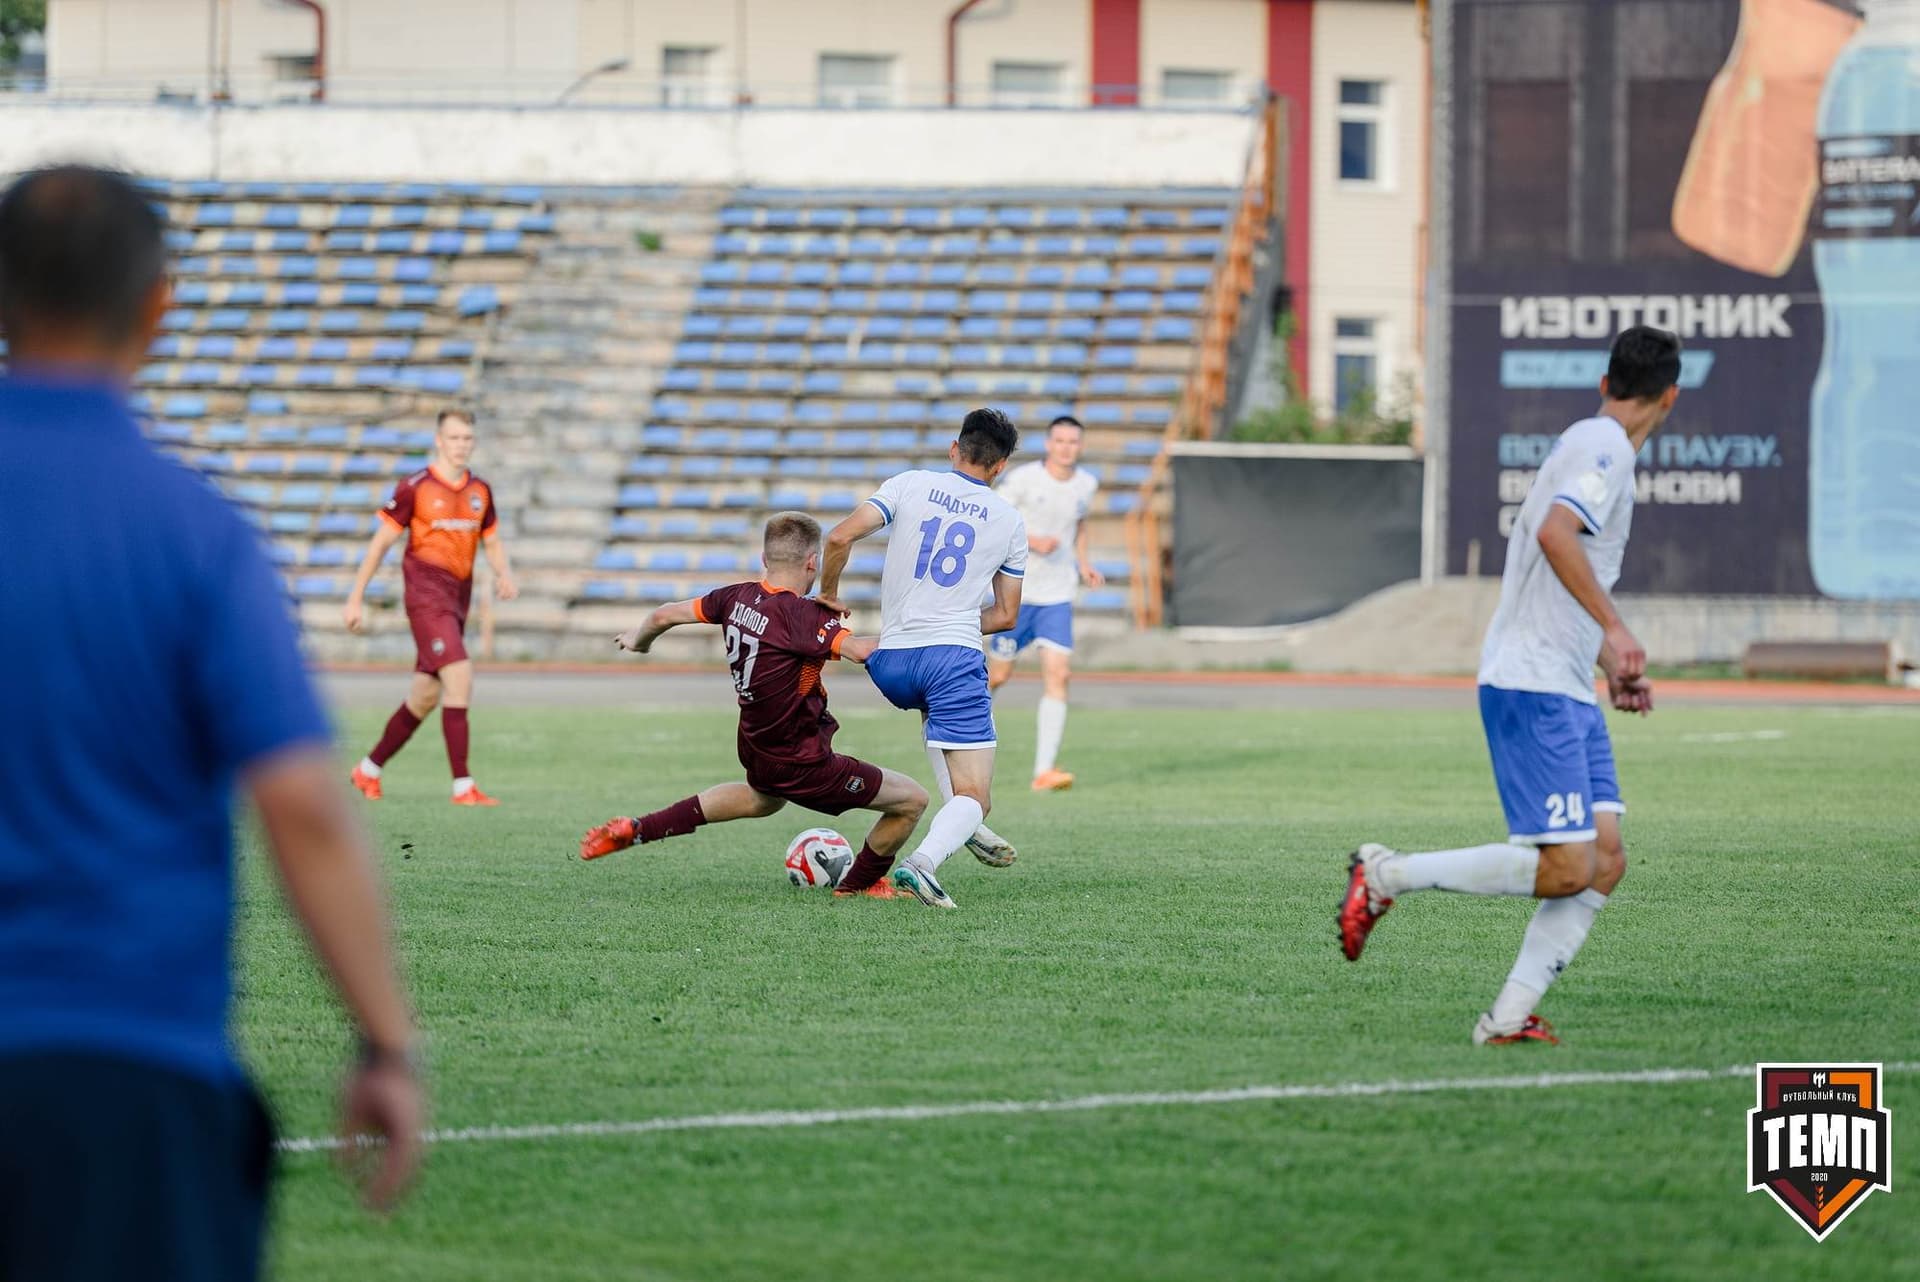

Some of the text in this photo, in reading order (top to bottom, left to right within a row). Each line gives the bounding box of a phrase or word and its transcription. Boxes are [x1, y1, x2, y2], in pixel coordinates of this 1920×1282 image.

[1502, 296, 1791, 338] ИЗОТОНИК
[1659, 434, 1782, 468] ПАУЗУ.
[928, 488, 988, 521] ШАДУРА
[914, 516, 976, 588] 18
[726, 624, 759, 691] 27
[1545, 792, 1586, 829] 24
